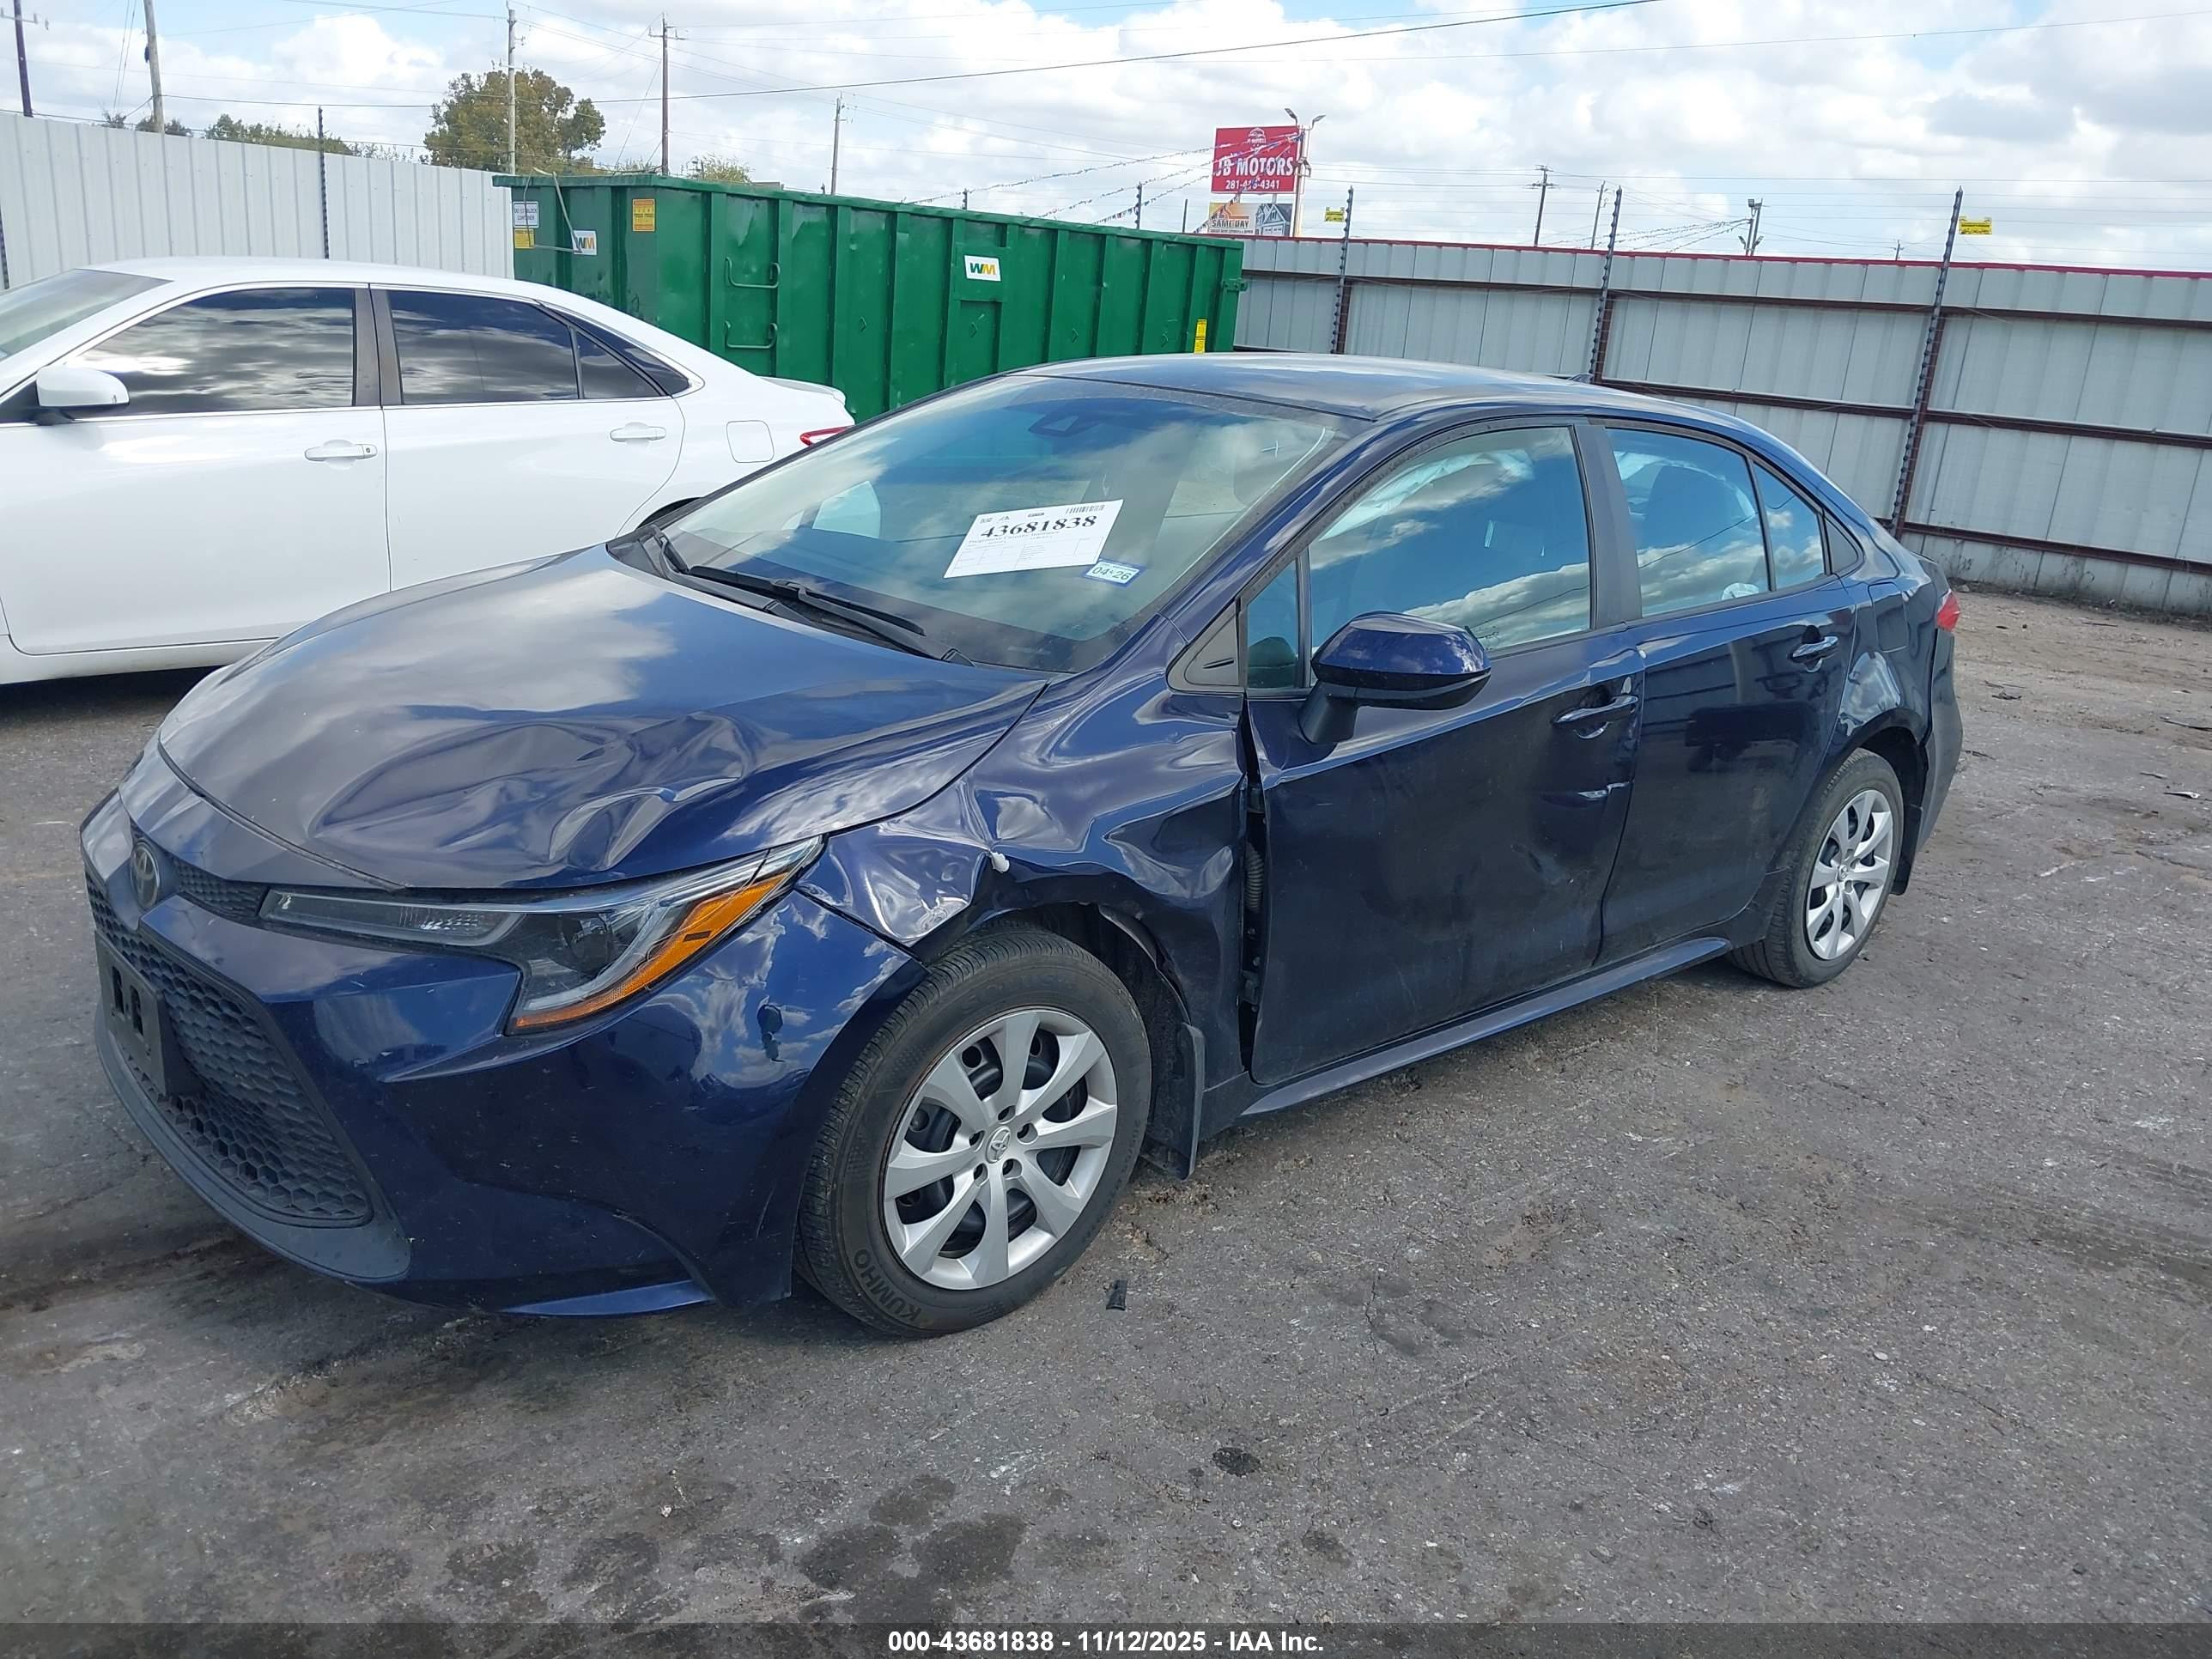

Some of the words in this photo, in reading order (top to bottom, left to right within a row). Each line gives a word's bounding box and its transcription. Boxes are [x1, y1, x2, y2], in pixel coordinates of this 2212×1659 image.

[1236, 156, 1294, 177] MOTORS
[1212, 219, 1232, 228] SAME
[969, 262, 996, 276] WM
[981, 514, 1097, 538] 43681838
[854, 1248, 922, 1322] KUMHO
